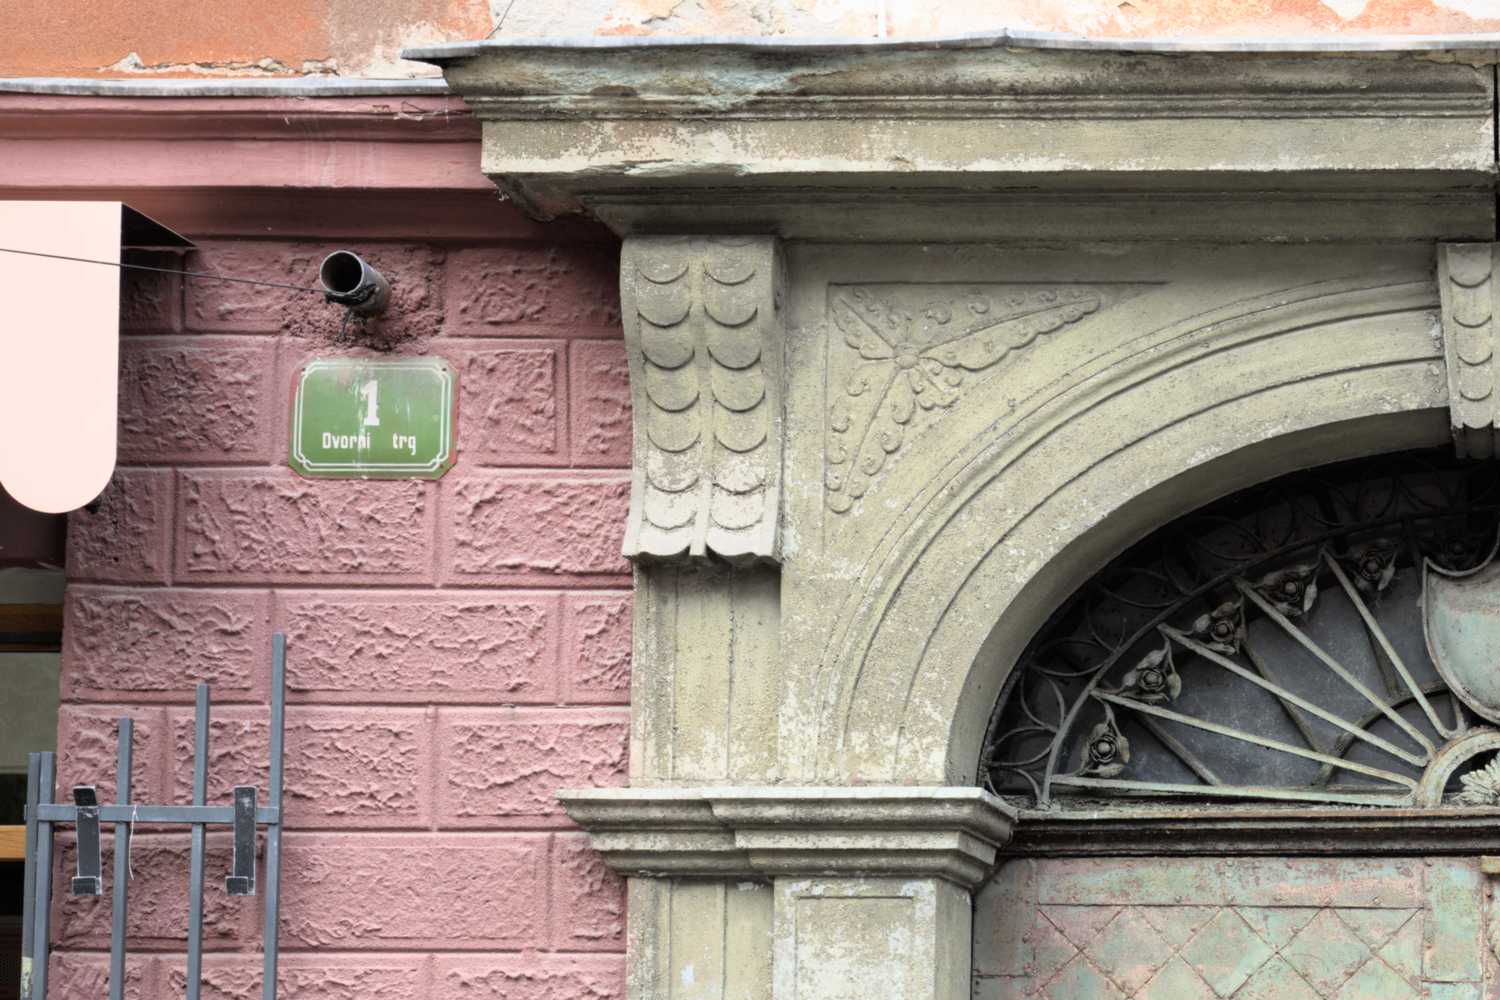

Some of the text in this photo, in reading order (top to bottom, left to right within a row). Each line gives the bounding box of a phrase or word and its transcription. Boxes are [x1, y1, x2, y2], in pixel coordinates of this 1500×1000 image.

[360, 379, 380, 426] 1
[321, 432, 417, 456] Dvorni trg
